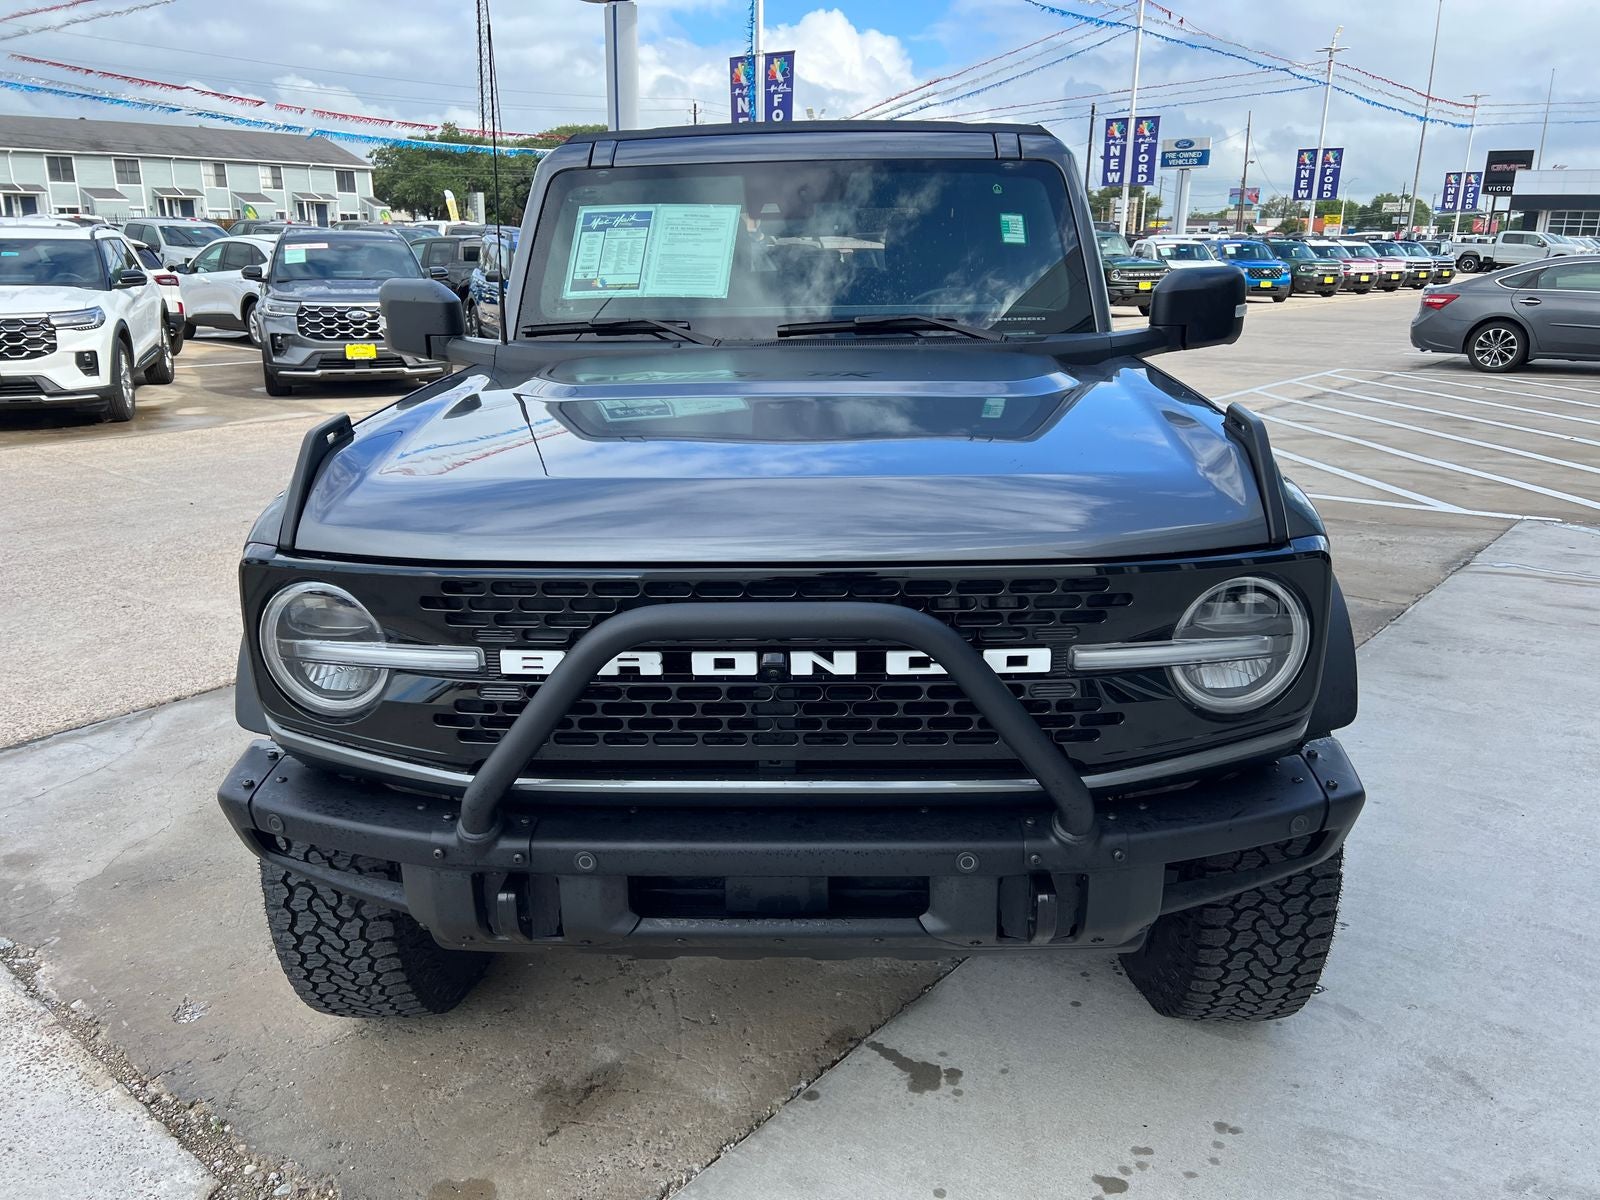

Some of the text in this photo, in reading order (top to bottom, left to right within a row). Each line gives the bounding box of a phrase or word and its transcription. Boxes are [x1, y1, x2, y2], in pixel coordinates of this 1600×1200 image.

[1107, 145, 1121, 183] NEW
[1137, 144, 1149, 183] FORD
[1165, 151, 1202, 159] PRE-OWNED
[1490, 164, 1527, 172] GMC
[1297, 169, 1310, 198] NEW
[1322, 168, 1334, 198] FORD
[1444, 187, 1455, 209] NEW
[1465, 187, 1474, 209] FORD
[499, 647, 1052, 676] BRONCO
